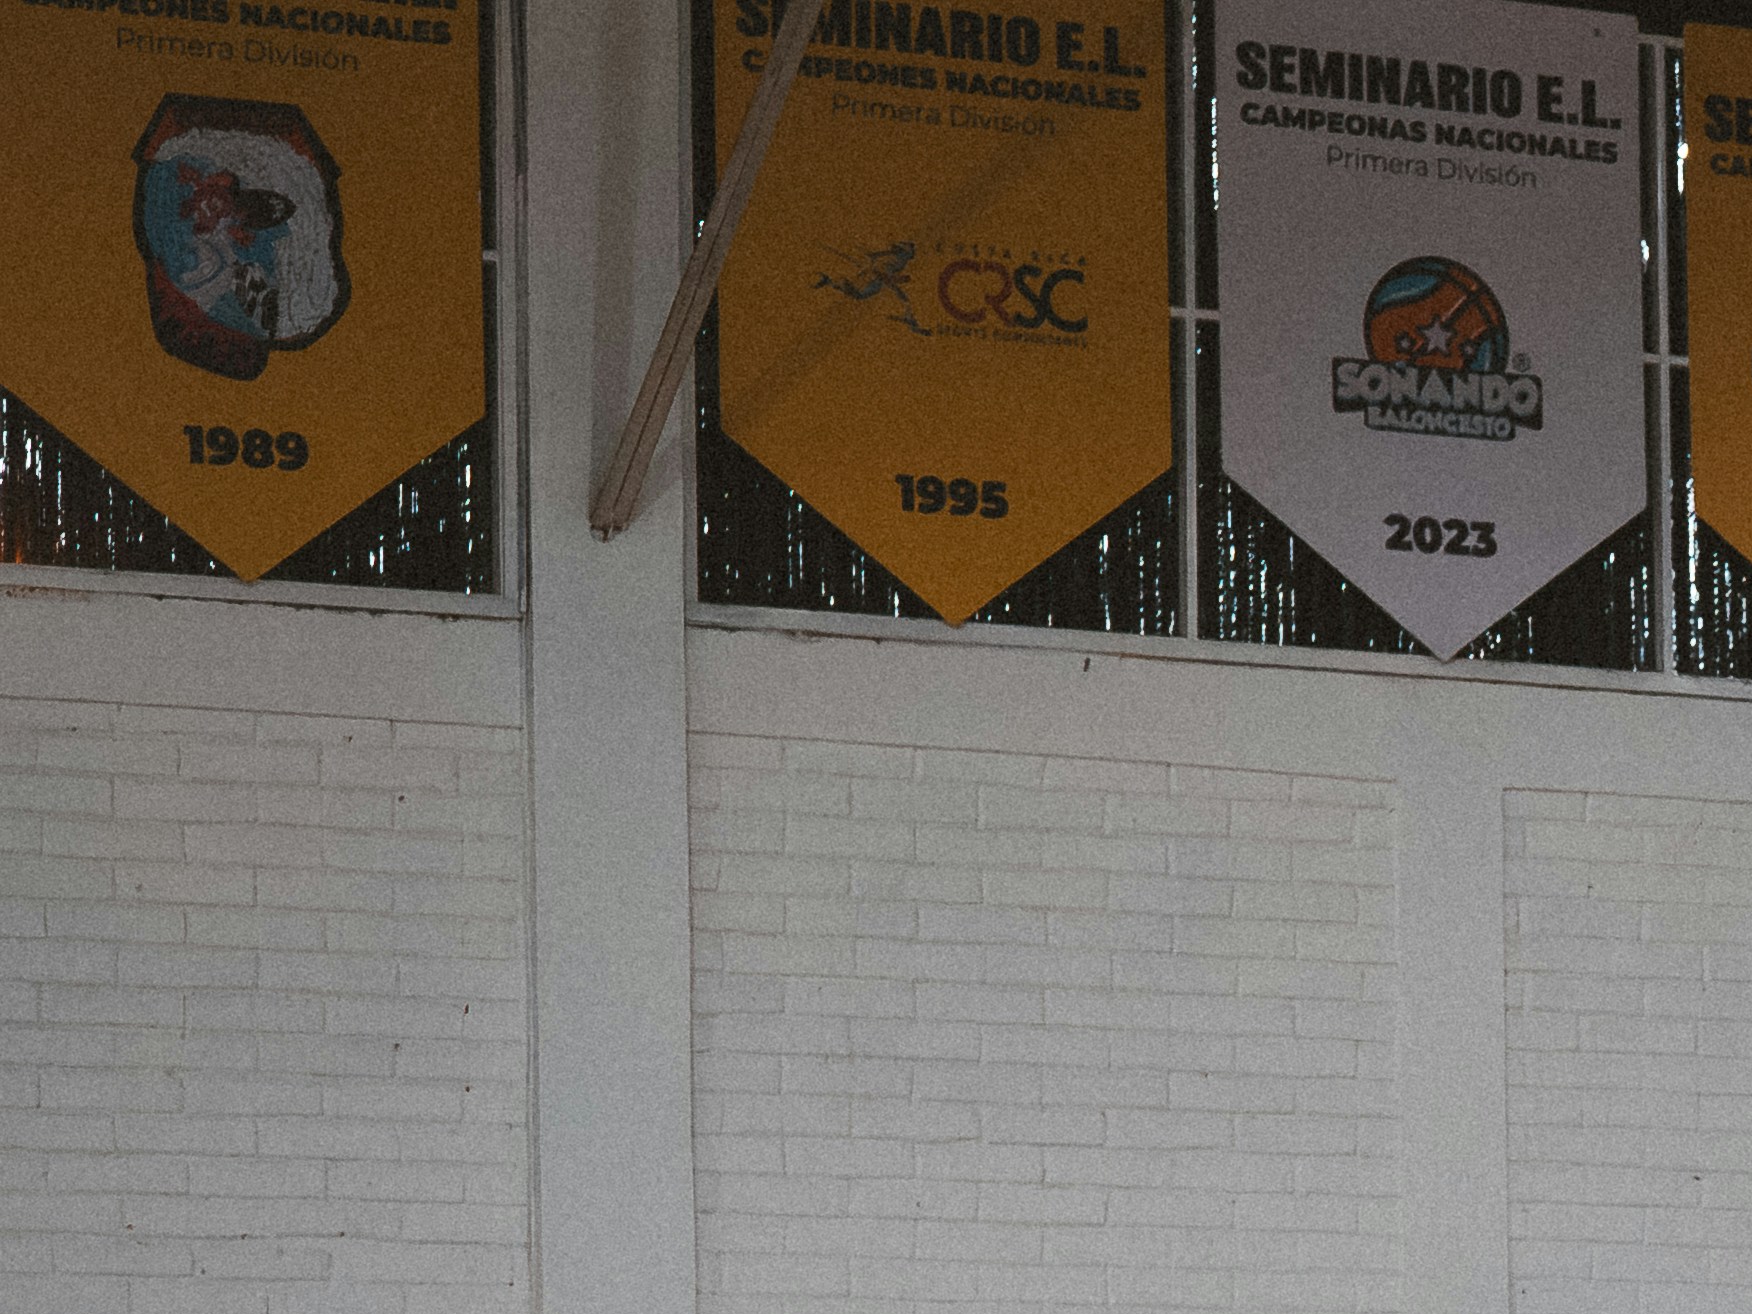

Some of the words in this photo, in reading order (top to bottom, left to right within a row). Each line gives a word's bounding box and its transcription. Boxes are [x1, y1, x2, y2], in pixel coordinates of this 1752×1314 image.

[239, 2, 452, 45] NACIONALES
[115, 26, 235, 62] Primera
[243, 39, 360, 73] División
[1056, 20, 1148, 79] E.L.
[741, 48, 938, 91] CPEONES
[946, 69, 1142, 112] NACIONALES
[1235, 40, 1523, 119] SEMINARIO
[1536, 73, 1622, 130] E.L.
[1239, 101, 1428, 143] CAMPEONAS
[1434, 123, 1620, 165] NACIONALES
[1327, 144, 1428, 178] Primera
[1437, 157, 1537, 190] División
[938, 258, 1088, 333] CRSC
[183, 425, 309, 471] 1989
[895, 474, 1009, 519] 1995
[1383, 513, 1498, 558] 2023
